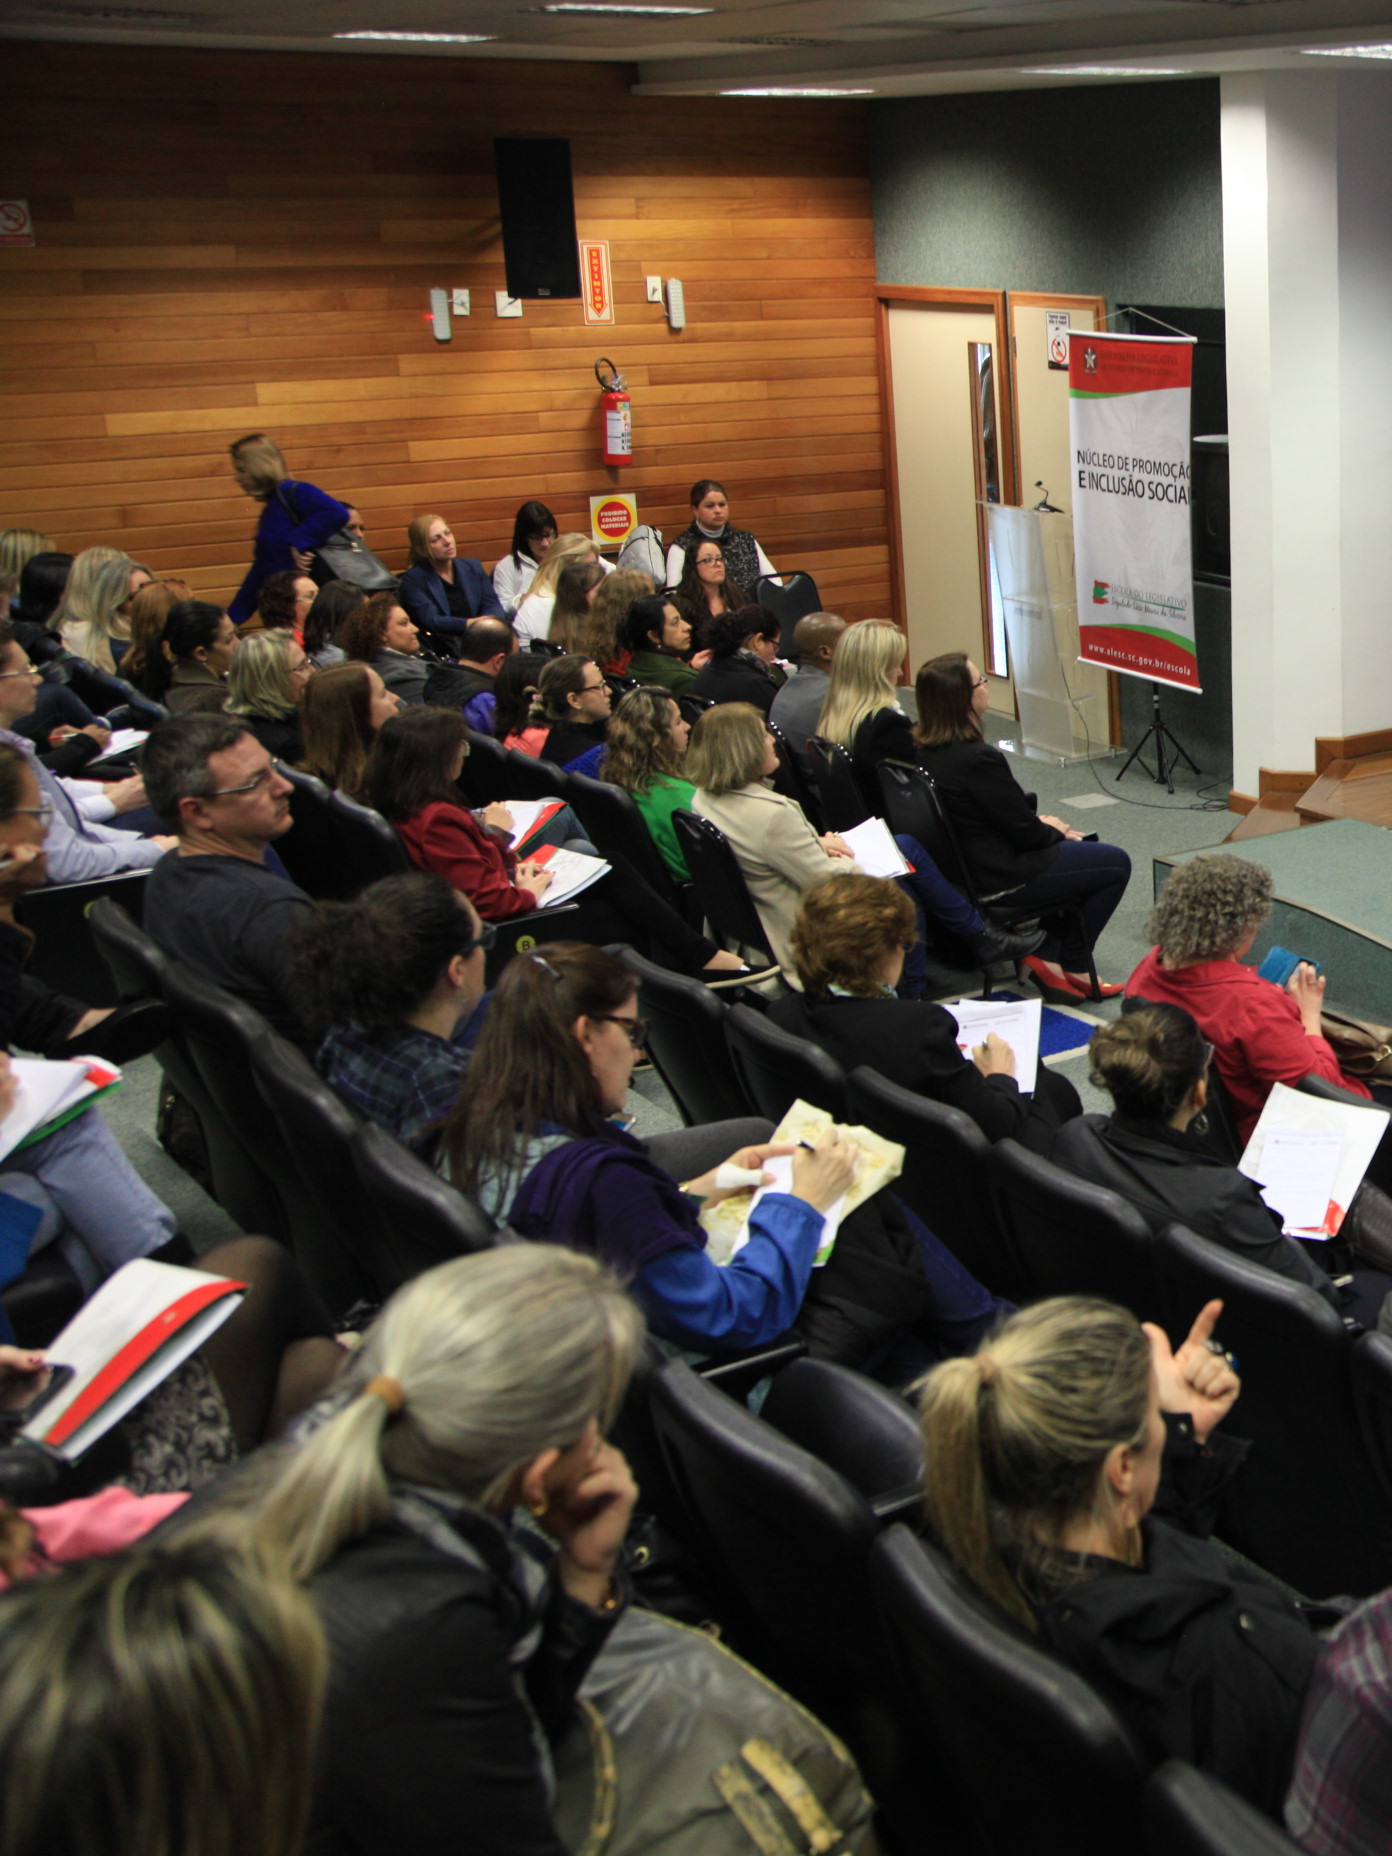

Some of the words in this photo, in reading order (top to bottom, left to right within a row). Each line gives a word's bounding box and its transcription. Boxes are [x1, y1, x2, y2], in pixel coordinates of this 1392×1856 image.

[1077, 448, 1115, 469] NÚCLEO
[1117, 456, 1130, 472] DE
[1078, 470, 1086, 488] E
[1088, 472, 1145, 498] INCLUSÃO
[601, 522, 629, 530] MATERIAIS
[1088, 643, 1191, 676] www.alesc.sc.gov.br/escola
